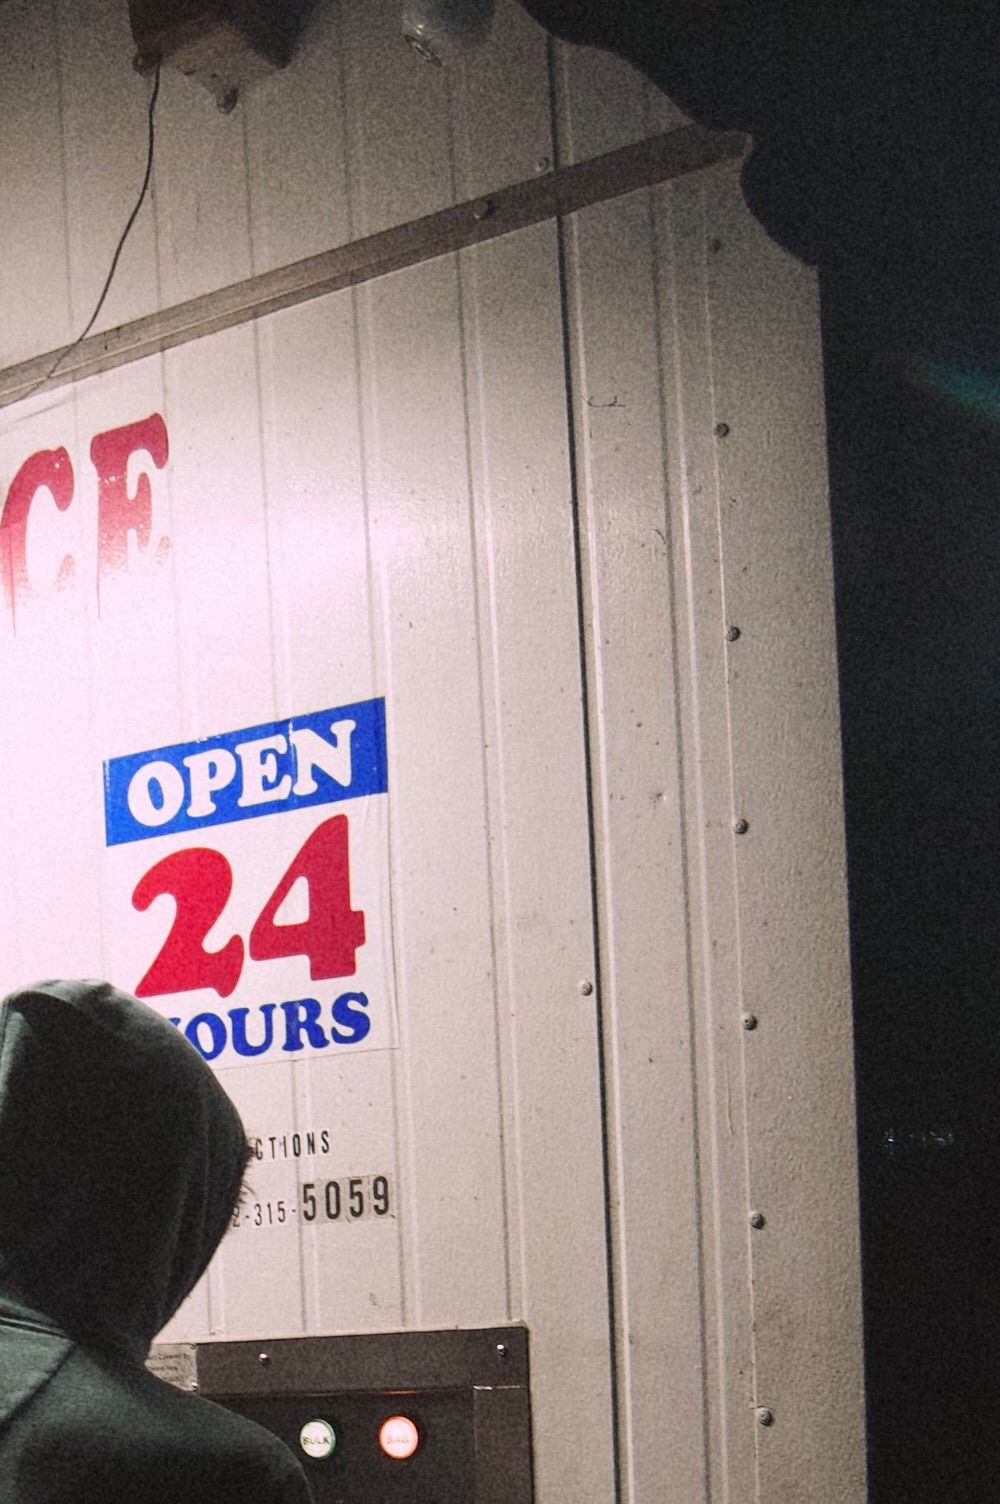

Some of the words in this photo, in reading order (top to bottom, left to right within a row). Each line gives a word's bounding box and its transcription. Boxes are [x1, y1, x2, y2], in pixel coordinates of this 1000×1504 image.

[127, 719, 356, 827] OPEN
[131, 813, 366, 999] 24
[165, 991, 371, 1061] OURS
